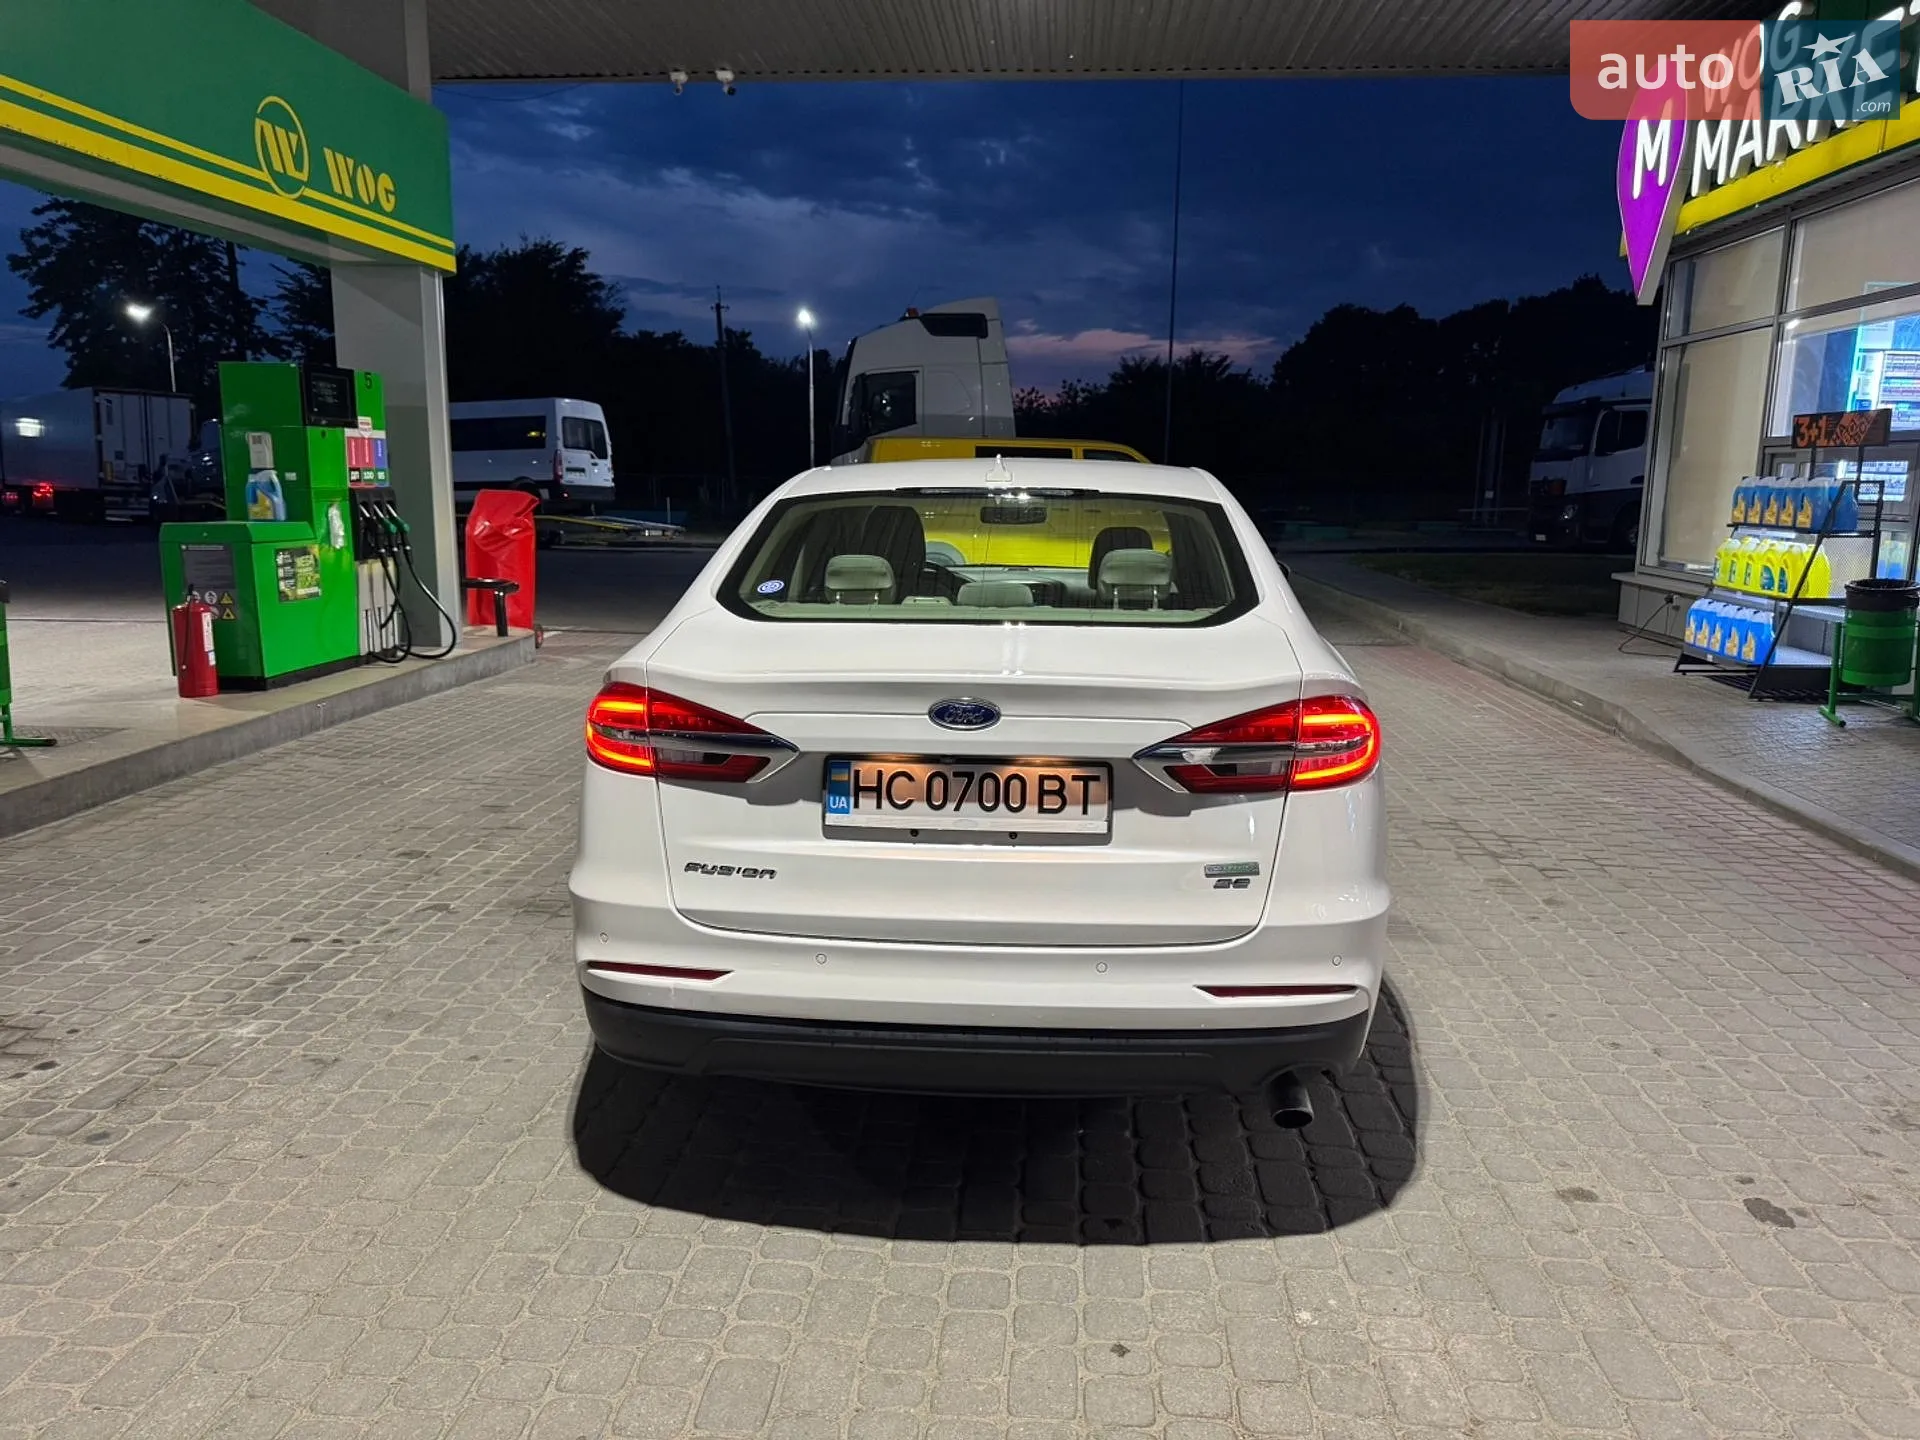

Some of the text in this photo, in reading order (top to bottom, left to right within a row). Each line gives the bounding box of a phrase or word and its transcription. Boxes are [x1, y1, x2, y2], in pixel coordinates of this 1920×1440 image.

[1632, 98, 1673, 199] M
[323, 147, 396, 213] WOG
[364, 372, 373, 389] 5
[830, 796, 848, 809] UA
[853, 769, 1100, 815] HC 0700 BT
[684, 862, 777, 879] FUSION
